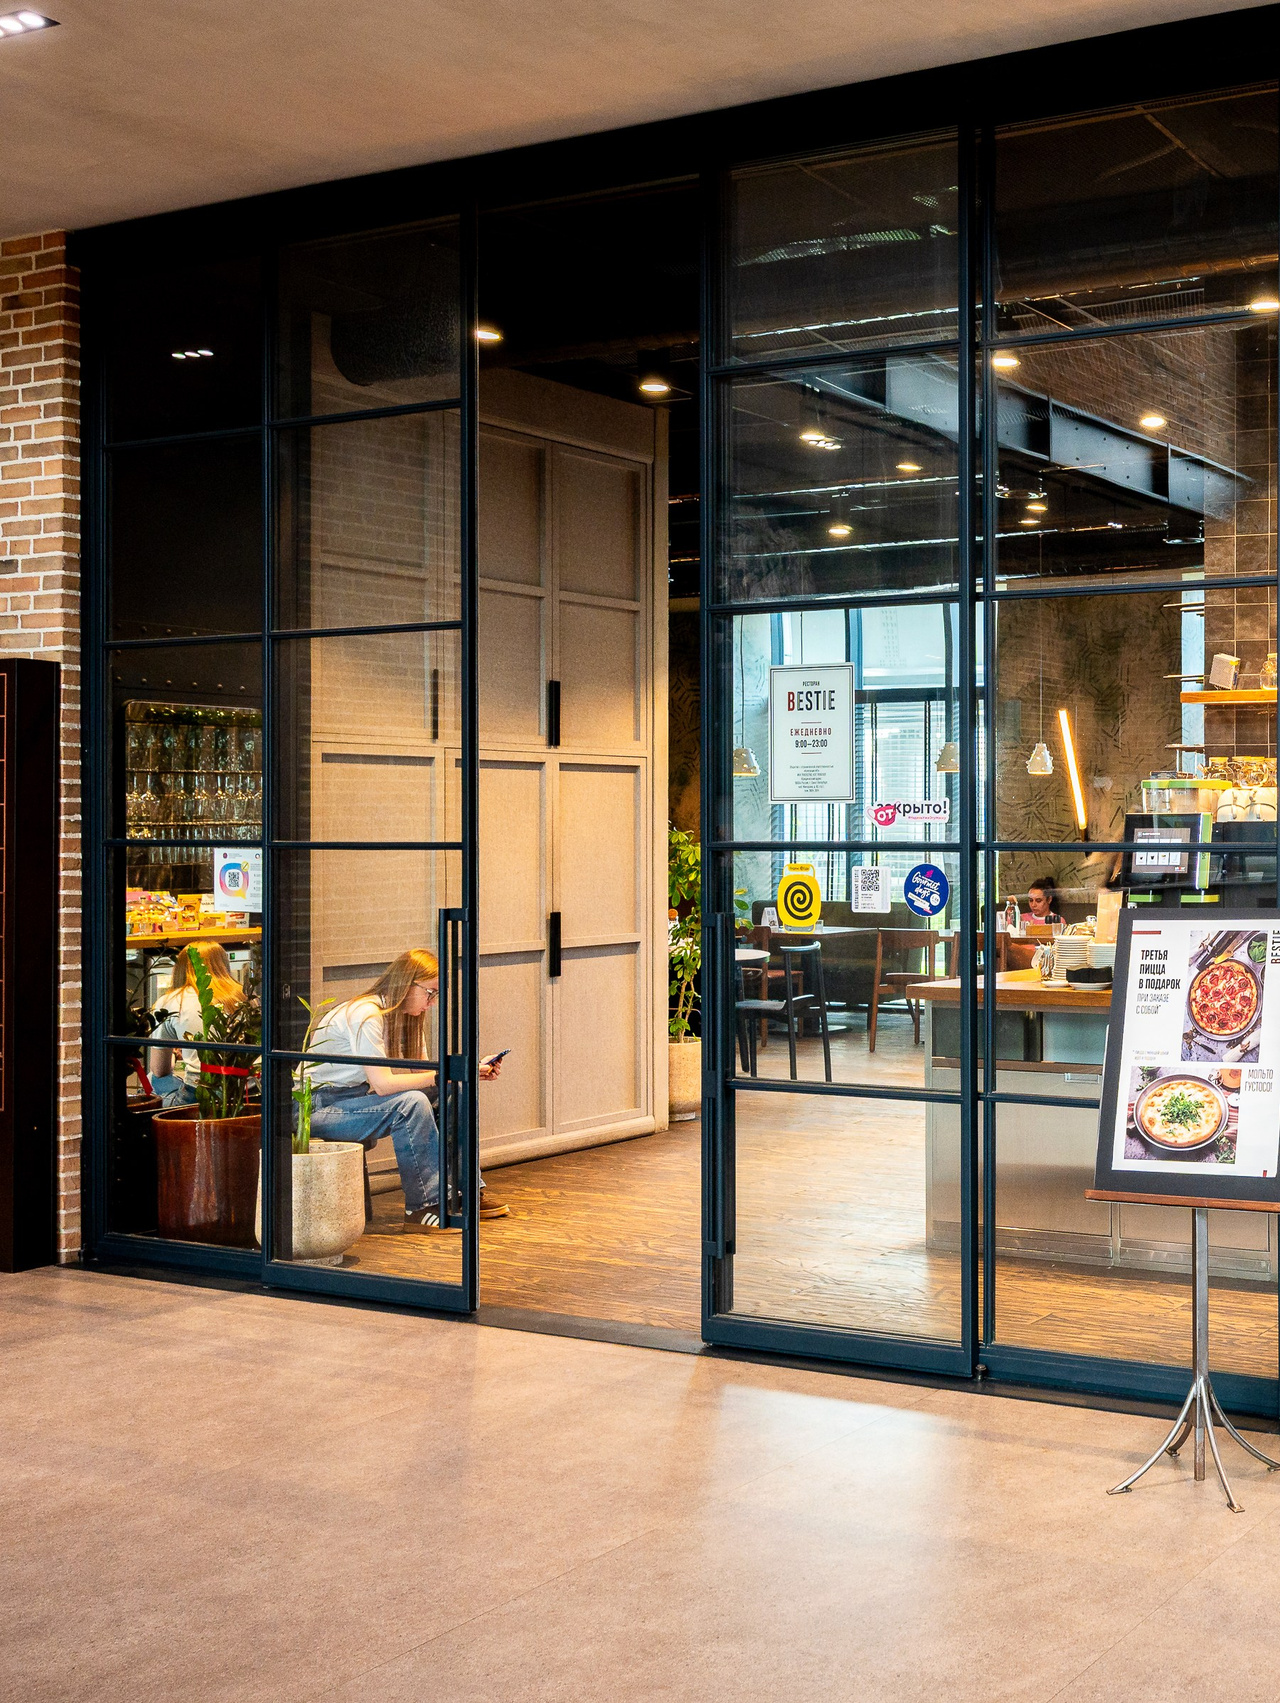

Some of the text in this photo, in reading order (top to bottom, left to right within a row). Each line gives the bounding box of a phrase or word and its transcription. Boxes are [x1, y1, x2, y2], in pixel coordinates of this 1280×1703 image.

[787, 690, 836, 711] BESTIE
[790, 727, 832, 736] ЕЖЕДНЕВНО
[1141, 949, 1169, 961] ТРЕТЬЯ
[1139, 963, 1166, 976] ПИЦЦА
[1138, 978, 1181, 991] В ПОДАРОК
[1136, 993, 1170, 1003] ПРИ ЗАКАЗЕ
[1135, 1005, 1140, 1015] С
[1247, 1068, 1274, 1080] МОЛЬТО
[1244, 1081, 1273, 1093] ГУСТОСО!
